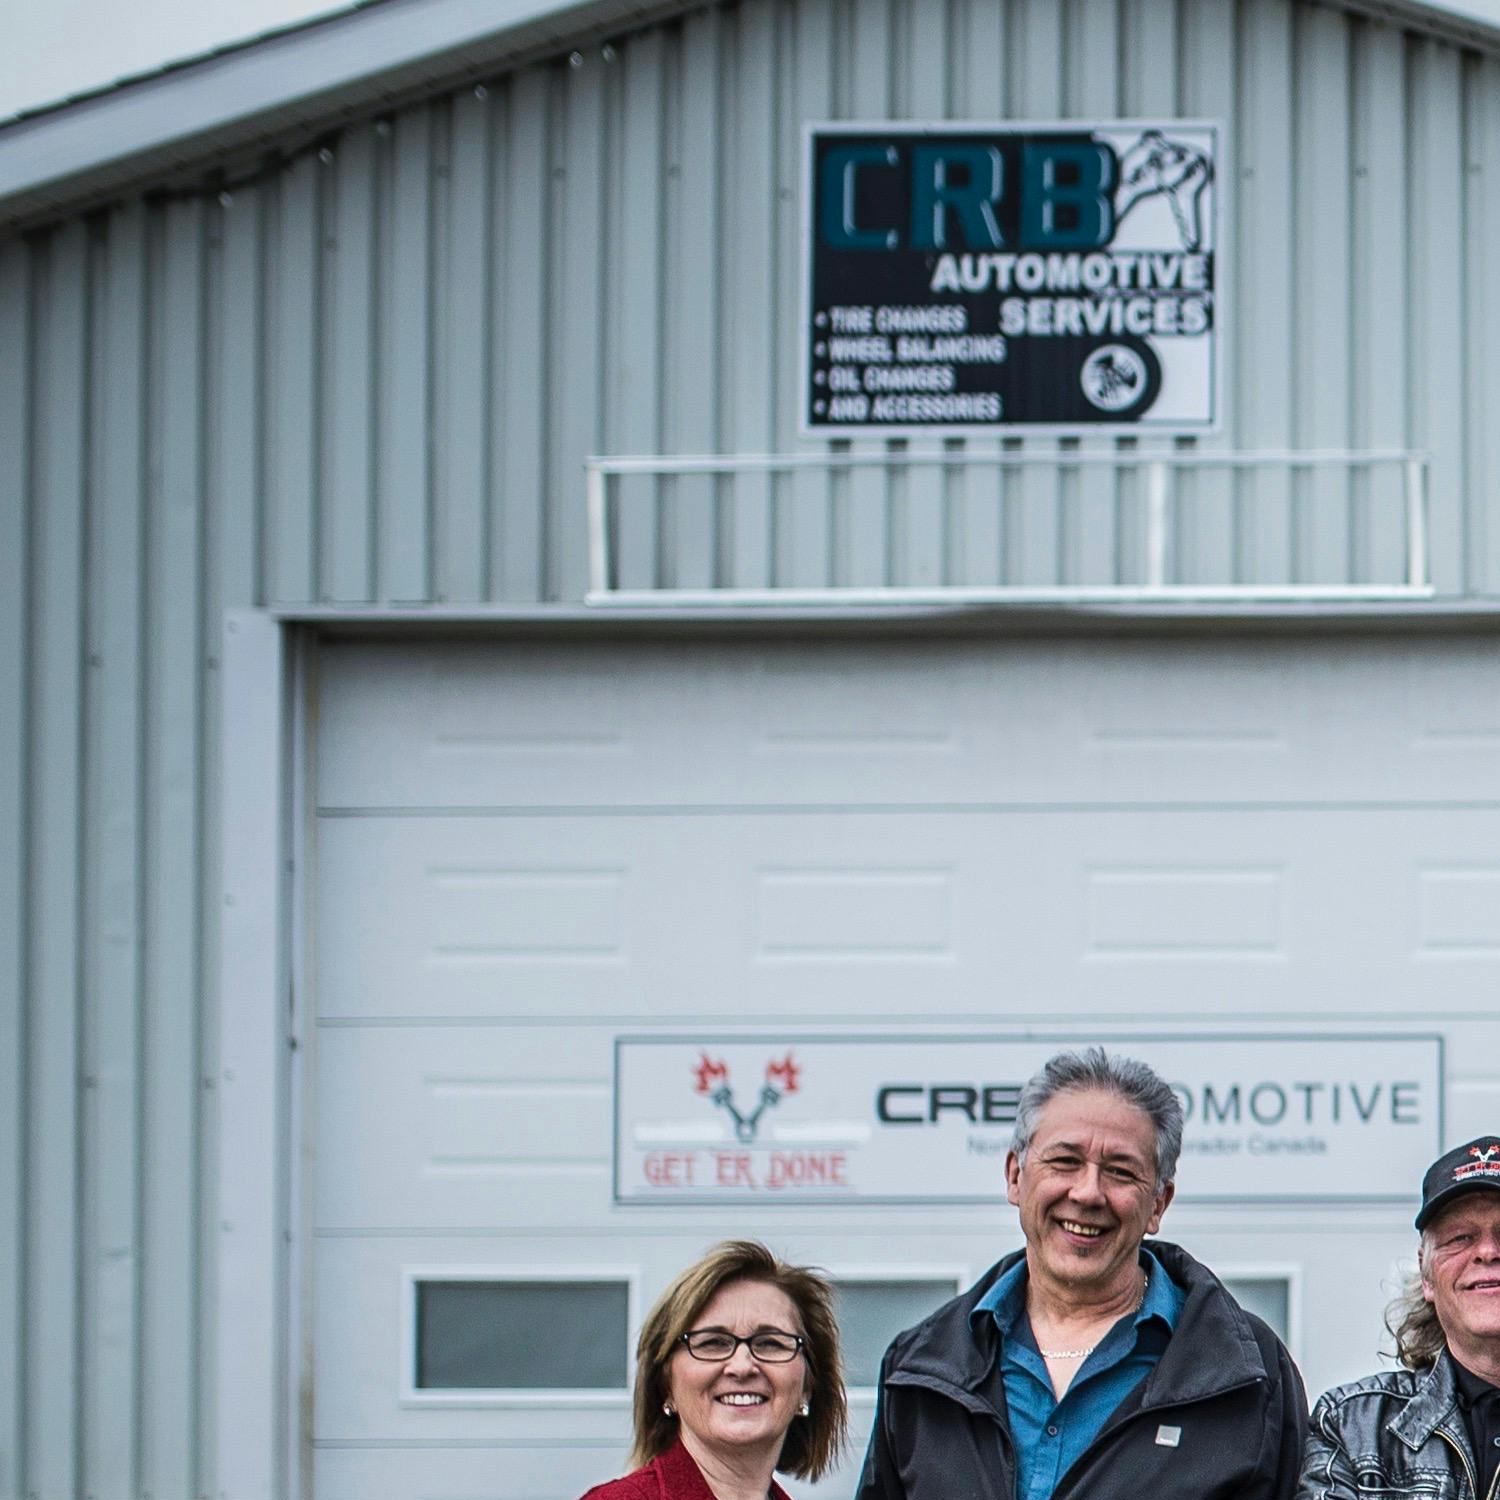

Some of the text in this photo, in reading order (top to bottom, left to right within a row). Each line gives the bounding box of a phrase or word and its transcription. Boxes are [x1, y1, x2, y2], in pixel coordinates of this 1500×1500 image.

[822, 143, 1113, 250] CRB
[931, 253, 1208, 292] AUTOMOTIVE
[829, 305, 968, 333] TIRE CHANGES
[1000, 298, 1208, 335] SERVICES
[829, 334, 1007, 363] WHEEL BALANCING
[828, 364, 956, 392] OIL CHANGES
[828, 392, 1002, 421] AND ACCESSORIES
[643, 1151, 696, 1187] GET
[765, 1151, 849, 1191] DONE
